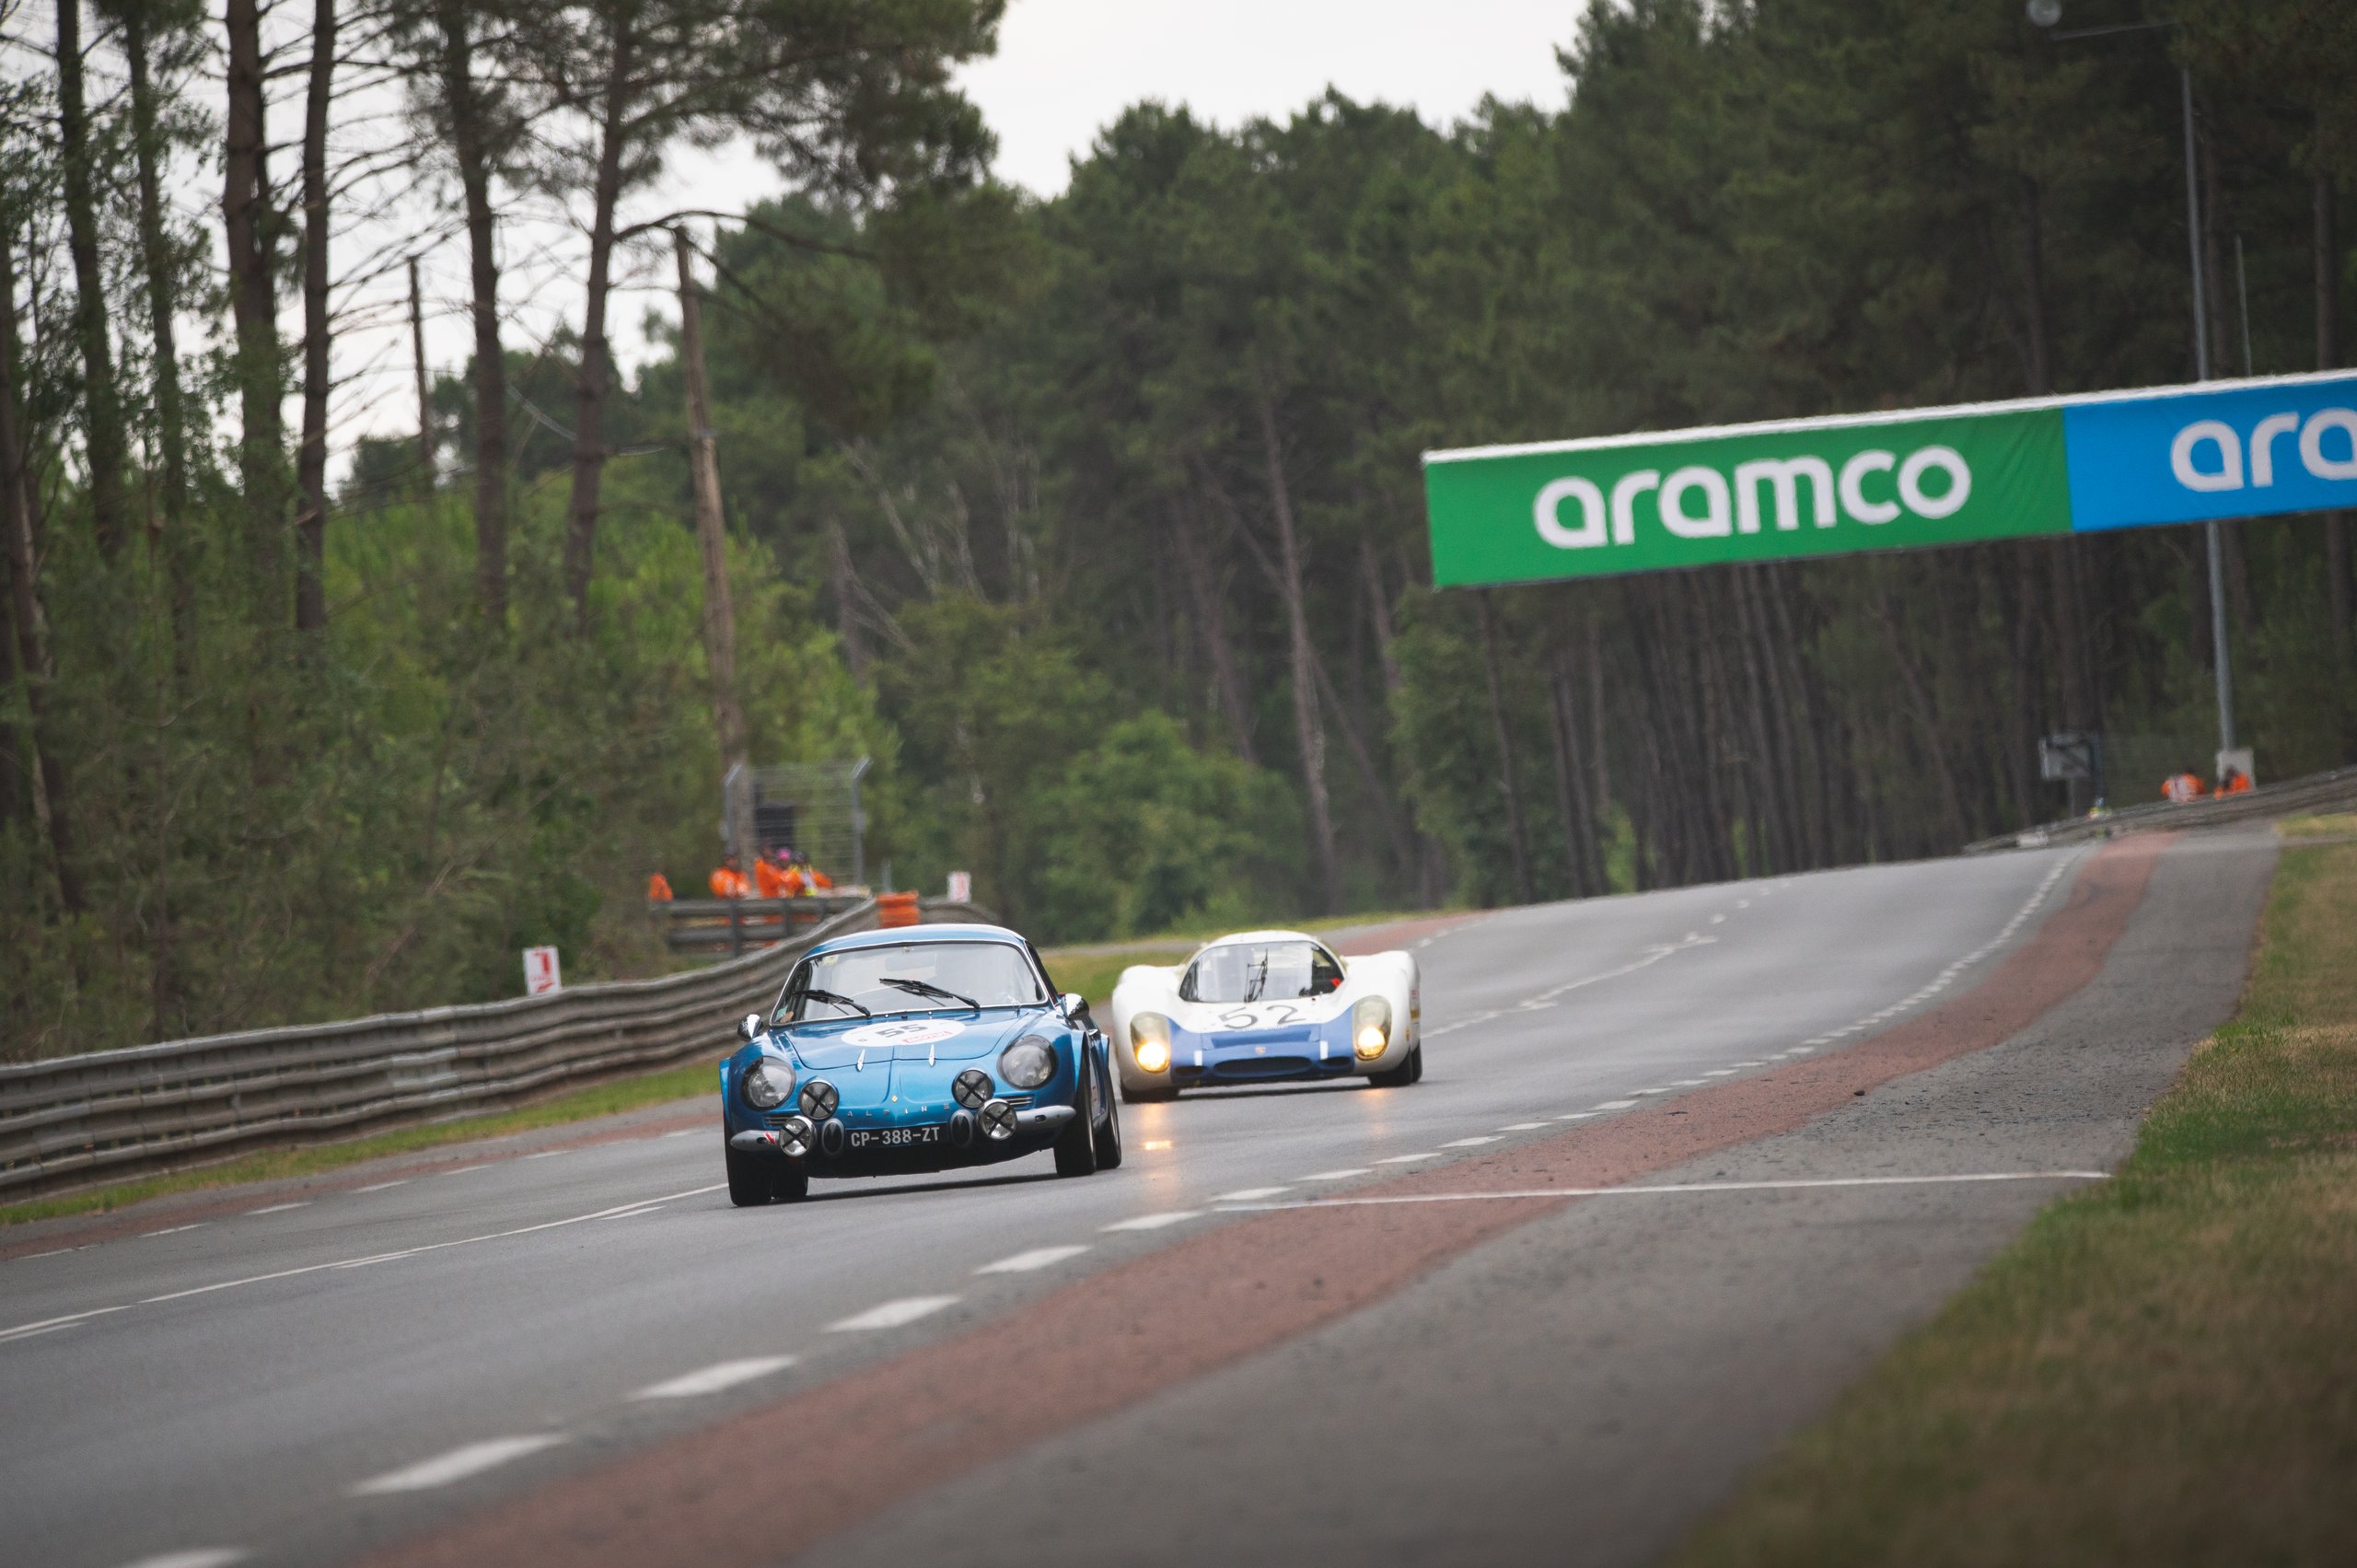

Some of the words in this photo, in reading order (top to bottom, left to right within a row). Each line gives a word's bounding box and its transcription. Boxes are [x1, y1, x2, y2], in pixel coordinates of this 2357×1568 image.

[1532, 446, 1972, 550] aramco
[1218, 1005, 1306, 1028] 52
[877, 1024, 928, 1038] 55
[847, 1104, 950, 1117] ALPINE
[851, 1127, 940, 1147] CP-388-ZT
